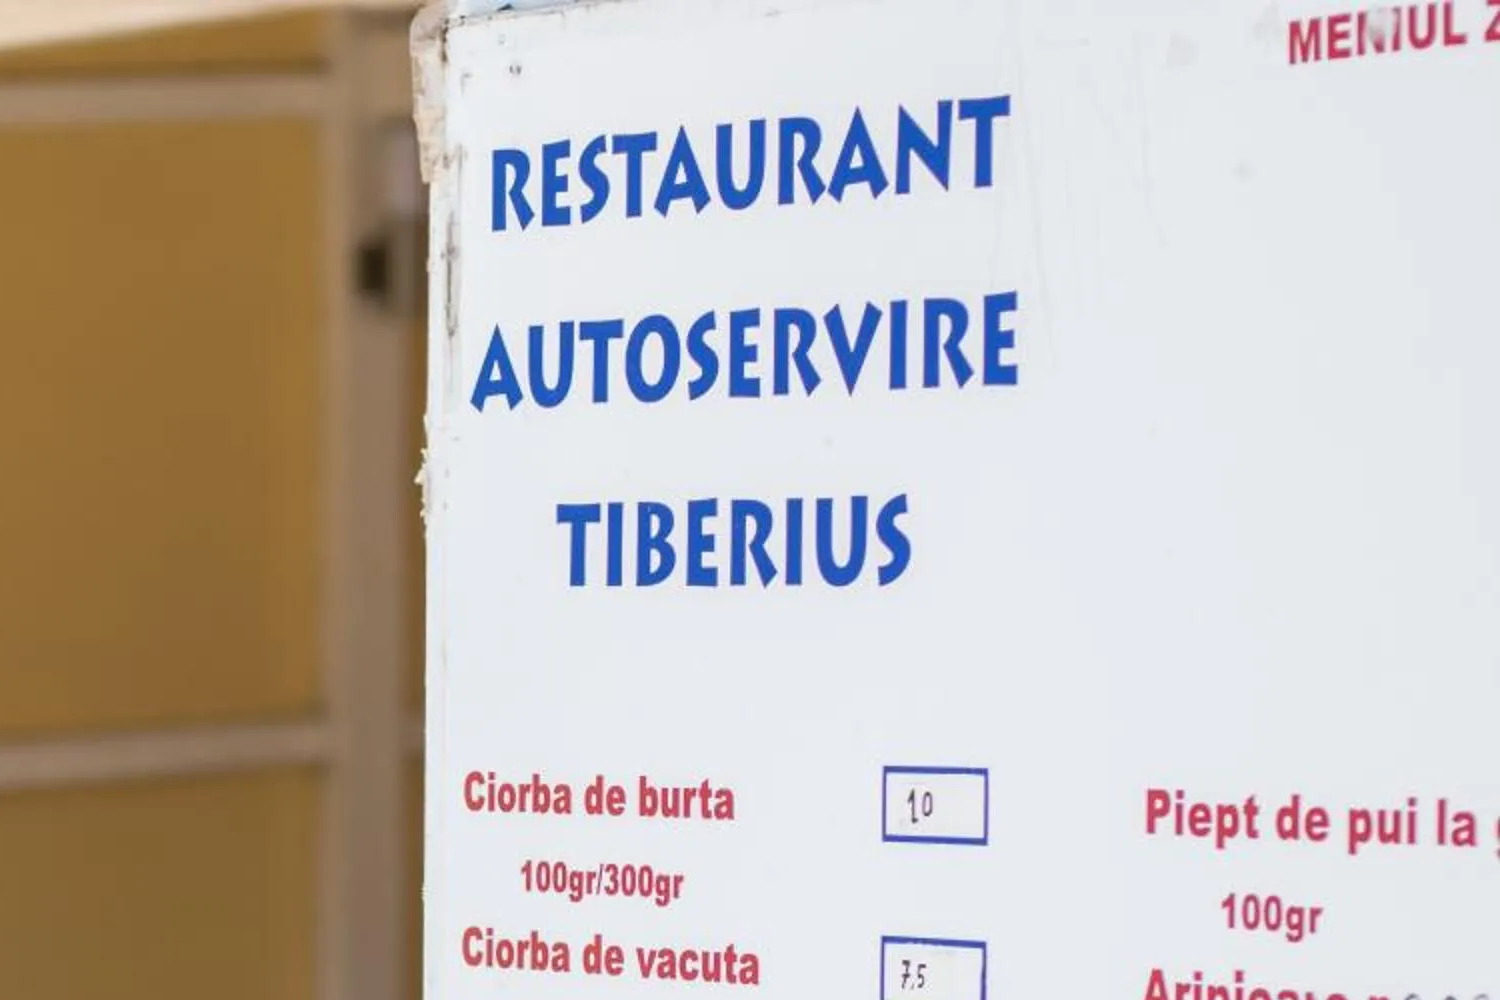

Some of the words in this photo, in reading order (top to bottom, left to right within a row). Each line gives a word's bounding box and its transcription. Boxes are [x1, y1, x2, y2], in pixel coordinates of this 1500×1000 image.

[491, 94, 1012, 233] RESTAURANT
[470, 290, 1020, 413] AUTOSERVIRE
[555, 493, 913, 588] TIBERIUS
[463, 771, 573, 815] Ciorba
[583, 775, 626, 816] de
[637, 775, 735, 820] burta
[907, 789, 933, 824] 10
[1145, 788, 1259, 851] Piept
[1275, 794, 1330, 843] de
[1347, 797, 1417, 856] pui
[1436, 798, 1477, 848] la
[521, 860, 684, 907] 100gr/300gr
[1220, 893, 1322, 943] 100gr
[462, 926, 571, 973] Ciorba
[582, 933, 625, 976] de
[635, 943, 760, 986] vacuta
